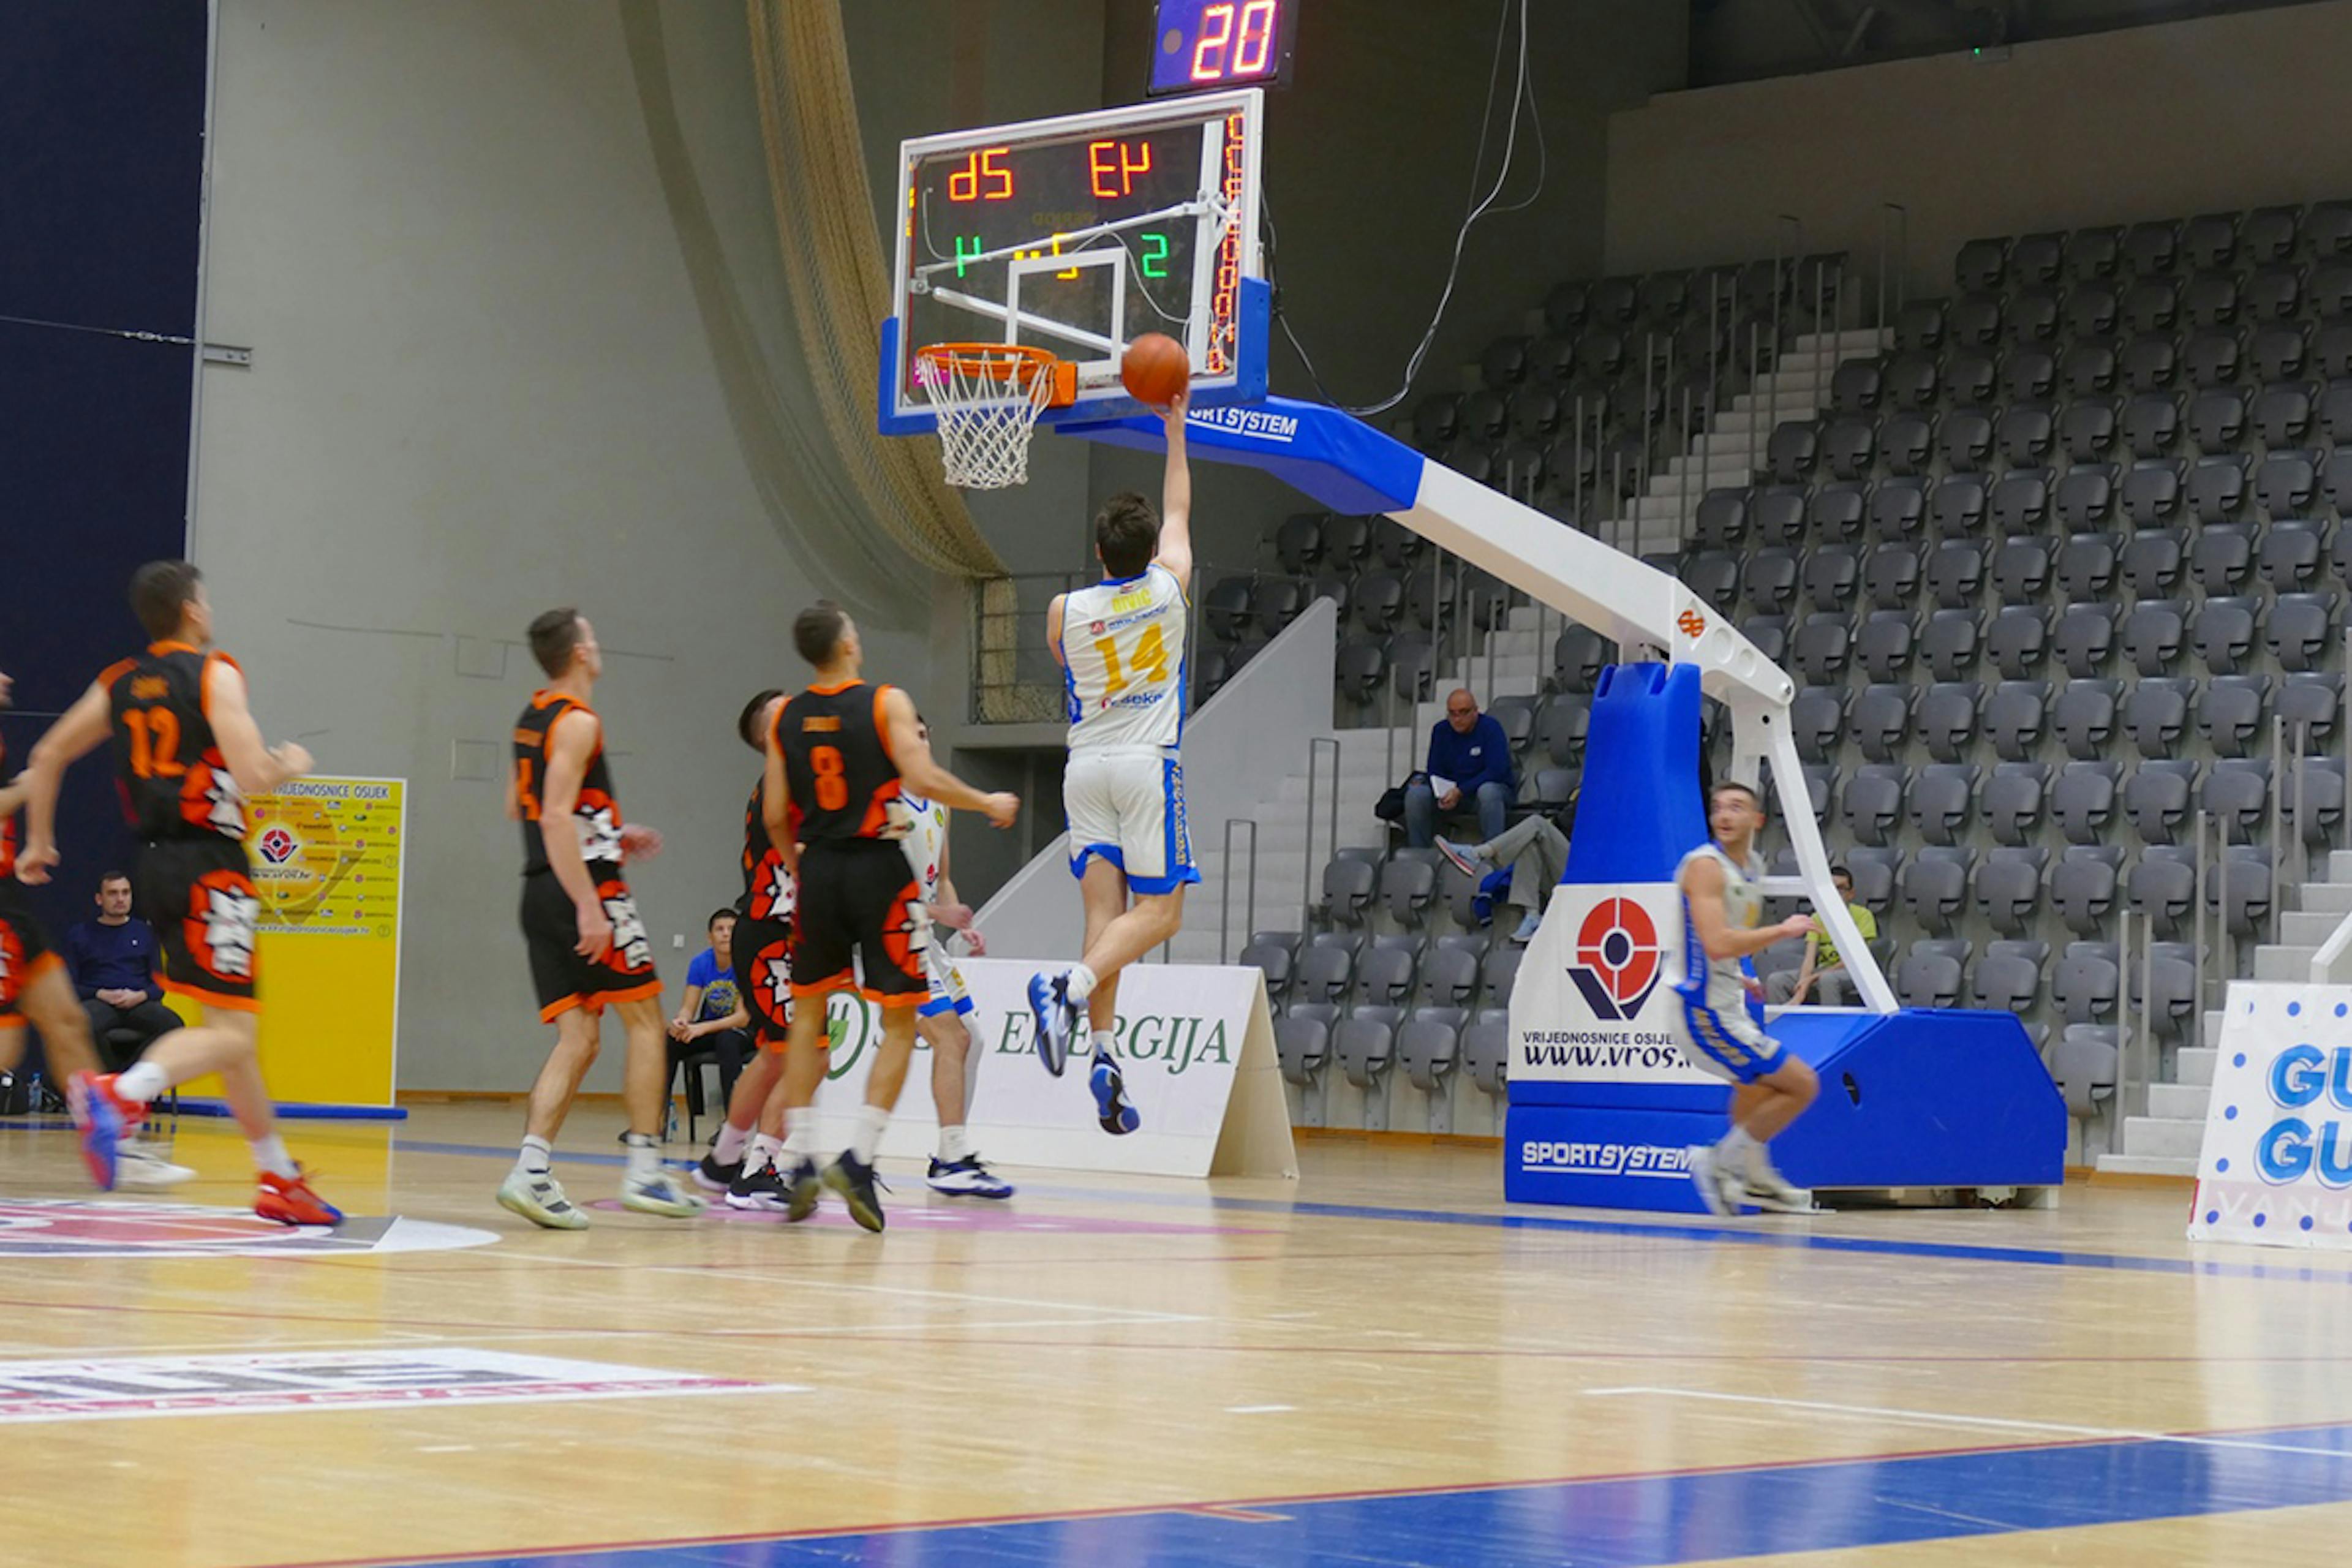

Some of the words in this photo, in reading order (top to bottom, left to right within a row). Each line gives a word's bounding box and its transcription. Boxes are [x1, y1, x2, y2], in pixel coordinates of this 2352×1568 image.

[1191, 0, 1278, 80] 20
[1188, 407, 1298, 437] ORTSYSTEM
[1094, 622, 1169, 693] 14
[122, 705, 186, 780] 12
[354, 786, 389, 798] OSIJEK
[810, 745, 848, 811] 8
[995, 1011, 1231, 1074] EERGIJA
[1523, 1031, 1630, 1045] VRIJEDNOSNICE
[1634, 1033, 1674, 1045] OSIJE
[1525, 1046, 1691, 1068] www.vros.
[1522, 1141, 1693, 1174] SPORTSYSTEM
